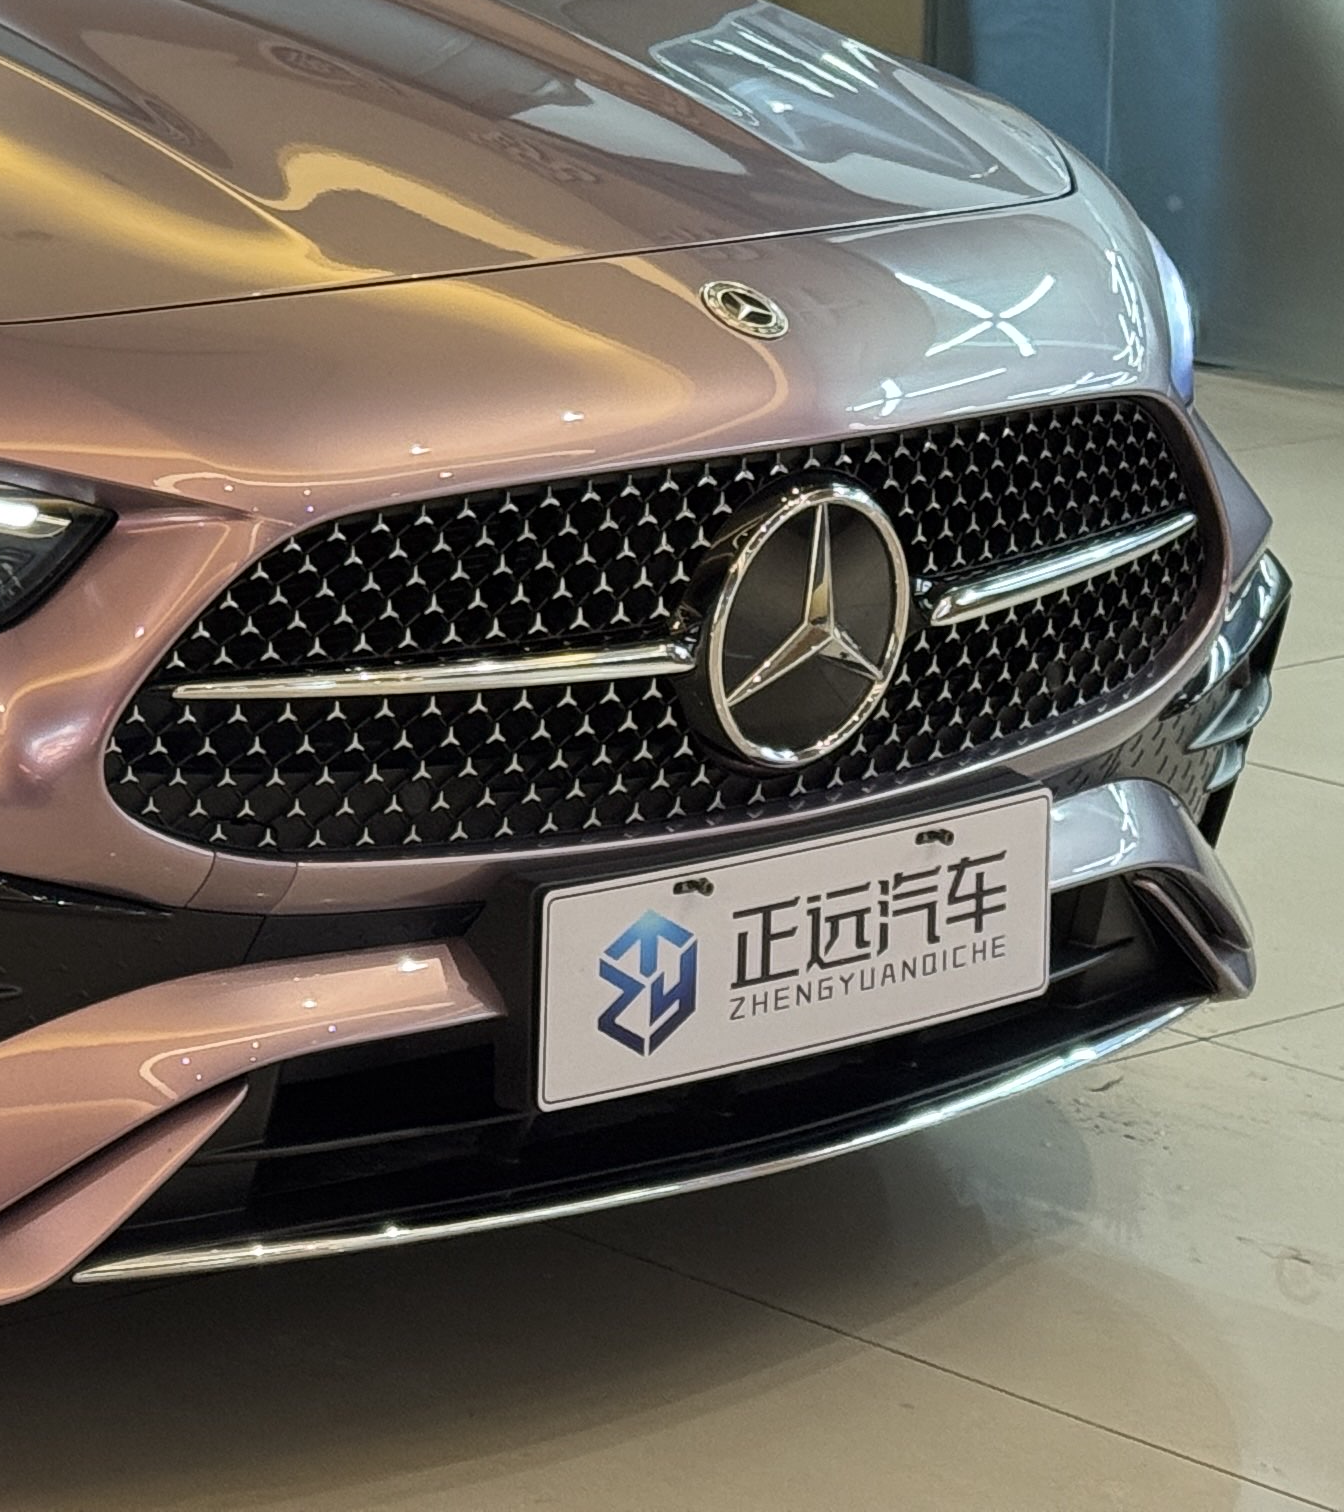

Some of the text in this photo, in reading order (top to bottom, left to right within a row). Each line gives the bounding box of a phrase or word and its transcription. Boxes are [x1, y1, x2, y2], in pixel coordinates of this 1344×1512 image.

[730, 849, 1008, 989] 正远汽车
[729, 934, 1007, 1021] ZHENGYUANQICHE
